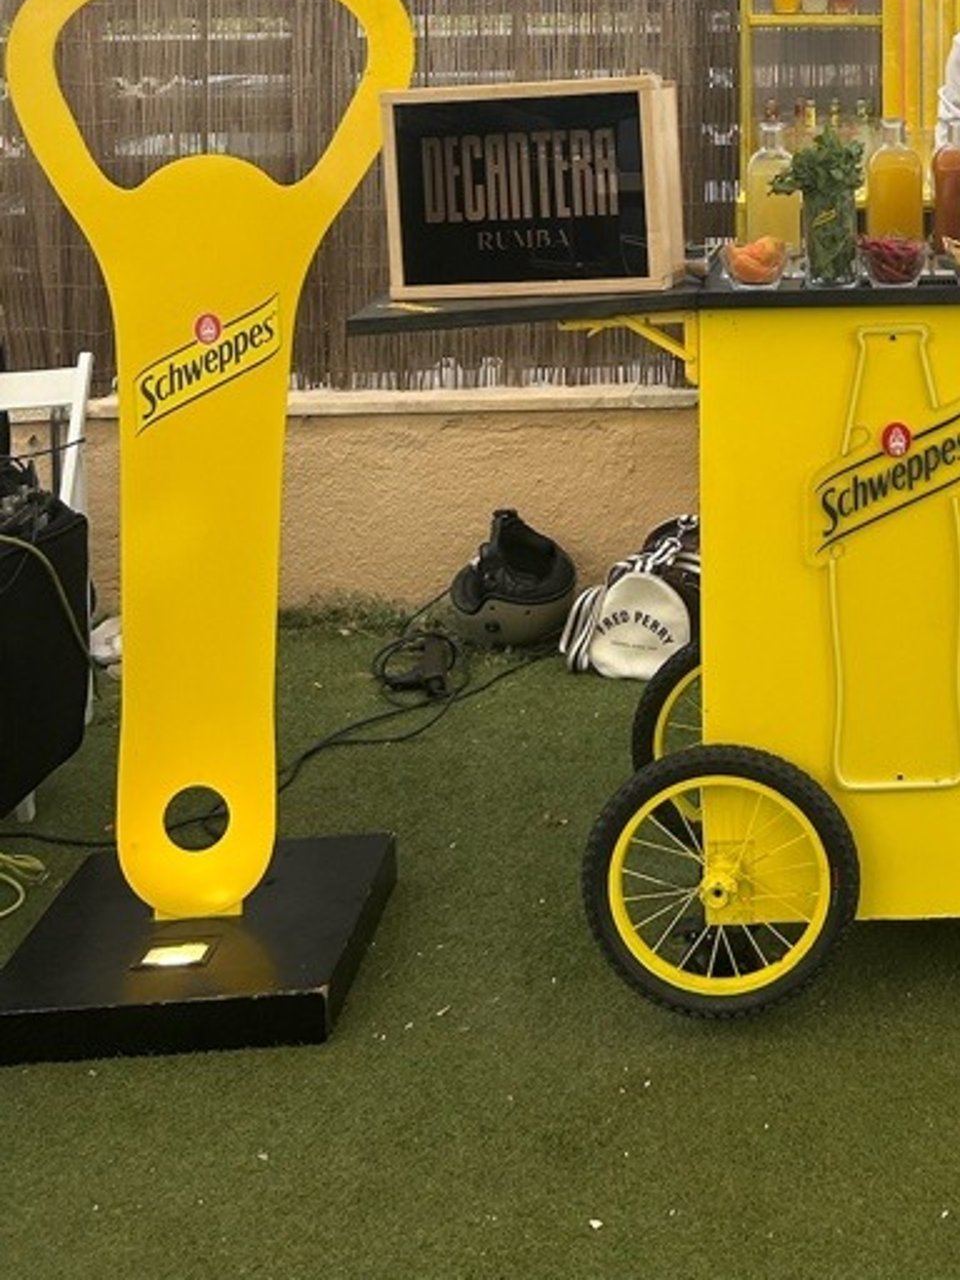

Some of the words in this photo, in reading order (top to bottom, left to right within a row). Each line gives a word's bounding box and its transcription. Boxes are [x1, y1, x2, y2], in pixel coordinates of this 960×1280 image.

[421, 127, 619, 224] DECANTERA
[477, 228, 570, 251] RUMBA
[140, 316, 275, 420] Schweppes
[596, 609, 630, 636] FRED
[633, 610, 675, 646] PERRY
